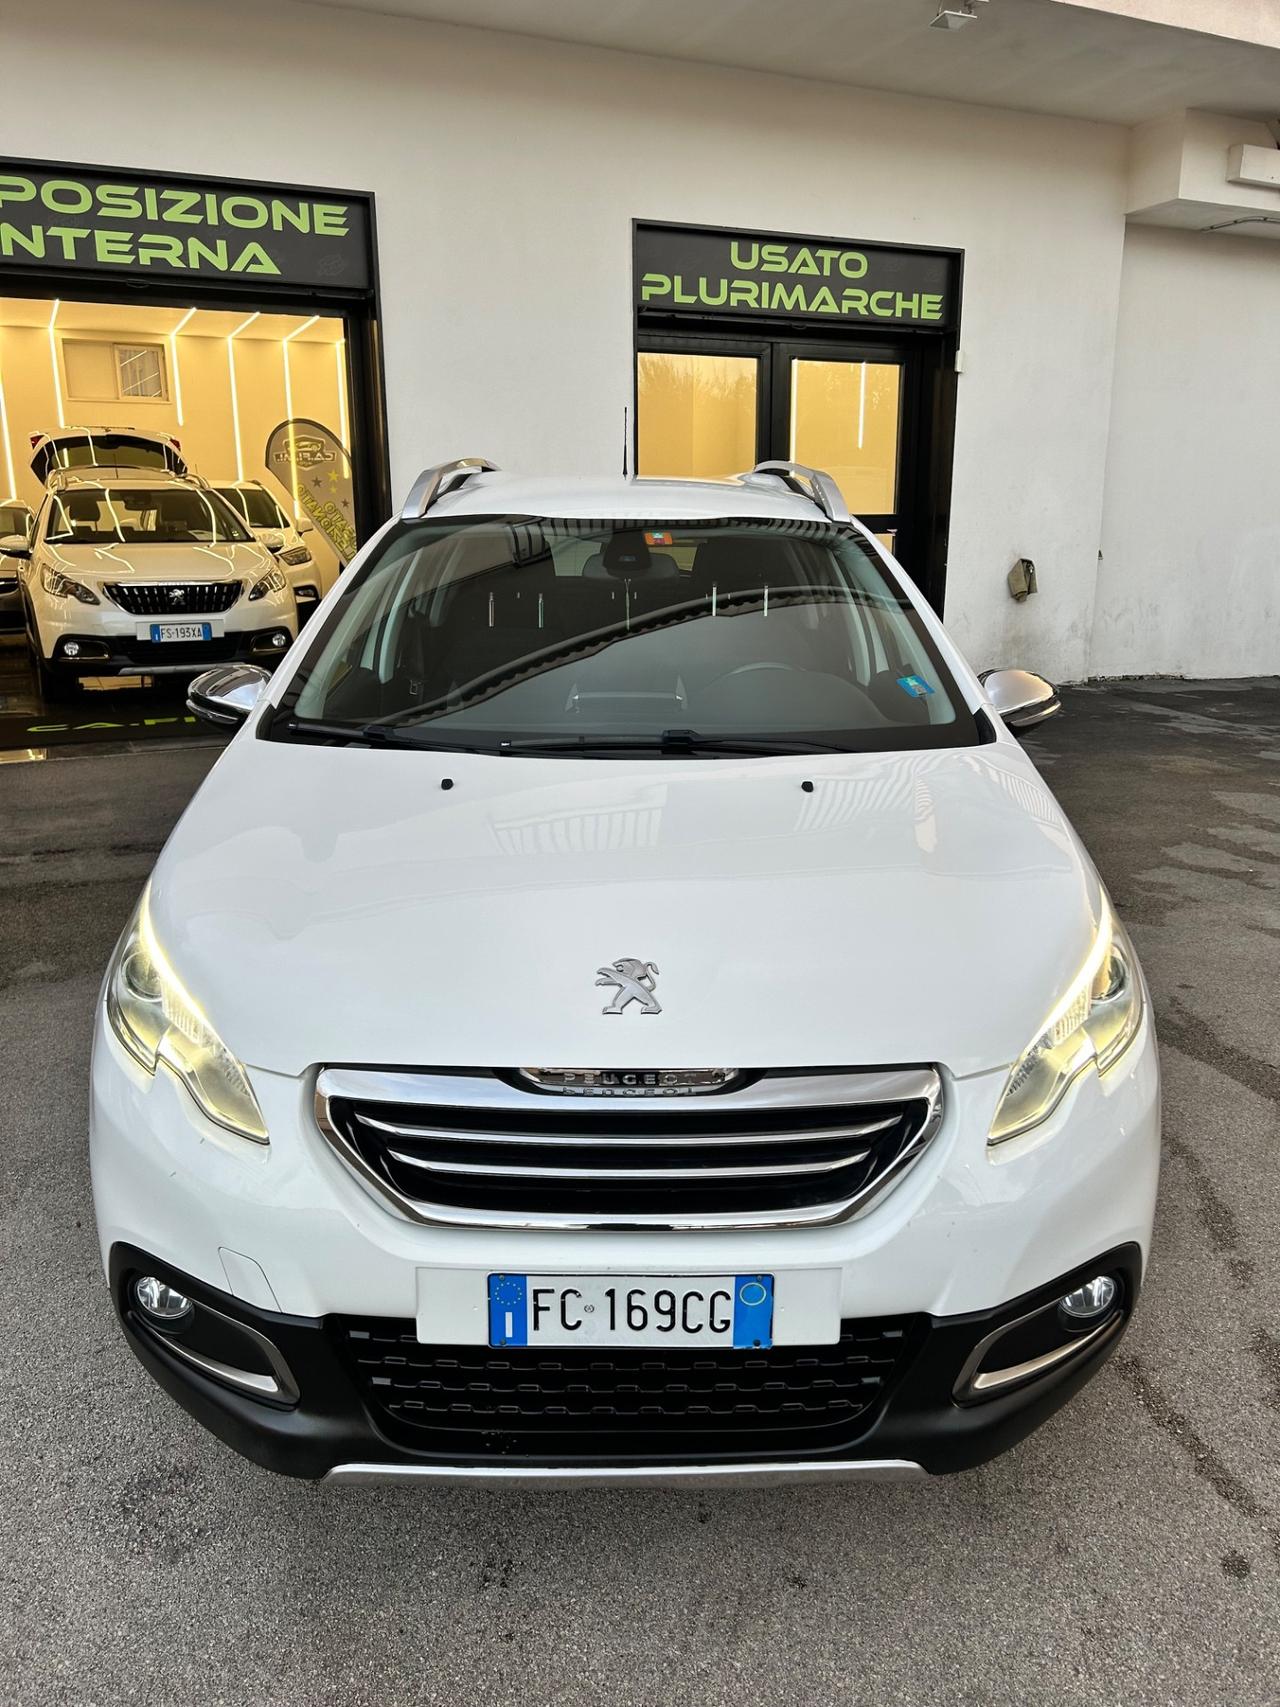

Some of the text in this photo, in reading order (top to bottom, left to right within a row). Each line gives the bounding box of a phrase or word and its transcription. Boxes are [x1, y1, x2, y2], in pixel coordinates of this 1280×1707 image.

[0, 222, 282, 275] NTERNA
[730, 241, 868, 279] USATO
[641, 273, 944, 320] PLURIMARCHE
